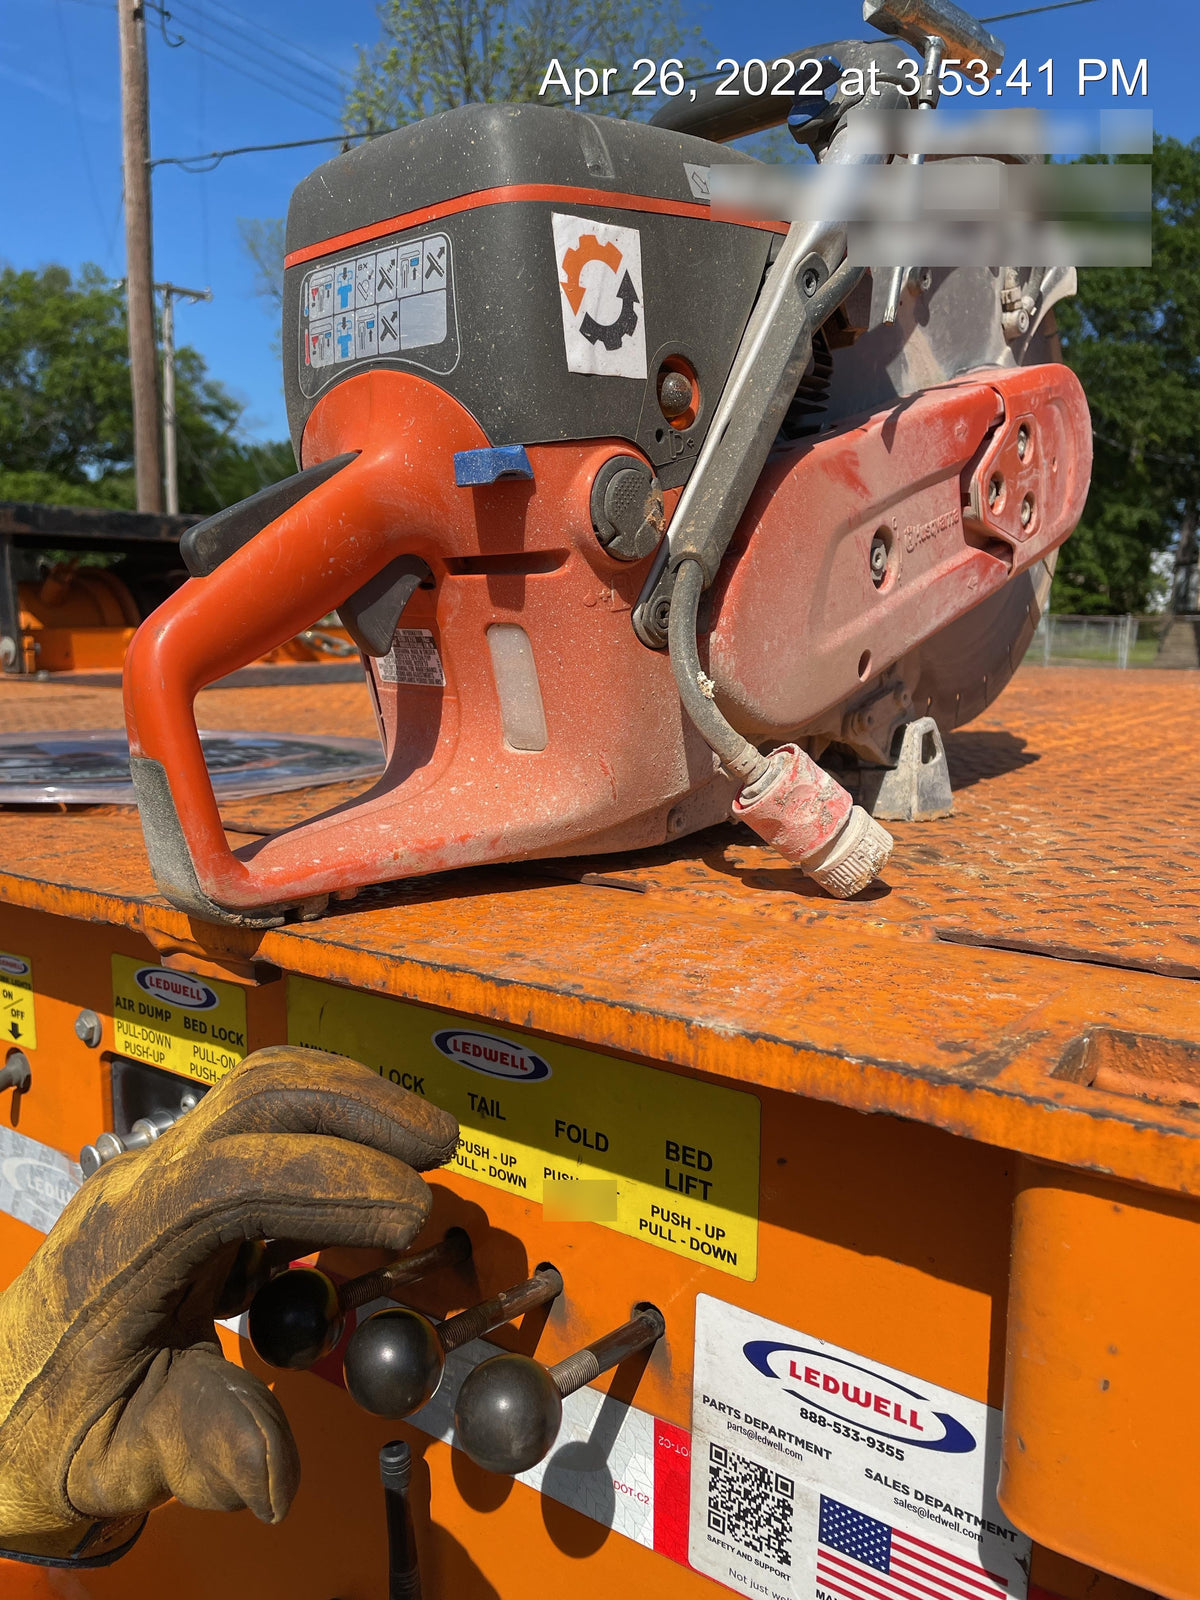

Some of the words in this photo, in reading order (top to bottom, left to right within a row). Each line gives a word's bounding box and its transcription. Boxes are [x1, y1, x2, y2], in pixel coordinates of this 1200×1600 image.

[2, 989, 14, 1000] ON
[148, 975, 203, 1001] LEDWELL
[11, 1008, 25, 1020] OFF
[115, 996, 136, 1013] AIR
[138, 1002, 172, 1022] DUMP
[117, 1020, 172, 1049] PULL-DOWN
[183, 1016, 208, 1035] BED
[211, 1025, 244, 1047] LOCK
[124, 1041, 166, 1065] PUSH-UP
[452, 1038, 529, 1073] LEDWELL
[467, 1092, 507, 1121] TAIL
[554, 1119, 609, 1153] FOLD
[458, 1139, 491, 1161] PUSH
[500, 1152, 518, 1168] UP
[665, 1140, 713, 1173] BED
[489, 1165, 527, 1189] DOWN
[665, 1168, 713, 1201] LIFT
[651, 1204, 691, 1231] PUSH
[705, 1223, 726, 1241] UP
[639, 1218, 677, 1243] PULL
[690, 1237, 738, 1266] DOWN
[789, 1360, 924, 1432] LEDWELL
[702, 1394, 742, 1420] PARTS
[744, 1413, 833, 1461] DEPARTMENT
[727, 1420, 803, 1462] parts@ledwell.com
[799, 1407, 905, 1462] 888-533-9355
[658, 1435, 691, 1458] OT-C2
[613, 1480, 650, 1505] DOT-C2
[864, 1468, 910, 1496] SALES
[914, 1489, 1018, 1543] DEPARTMENT
[893, 1496, 984, 1544] sales@ledwell.com
[707, 1534, 735, 1553] SAFETY
[736, 1550, 753, 1562] AND
[754, 1558, 791, 1582] SUPPORT
[728, 1567, 747, 1584] Not
[748, 1578, 769, 1596] just
